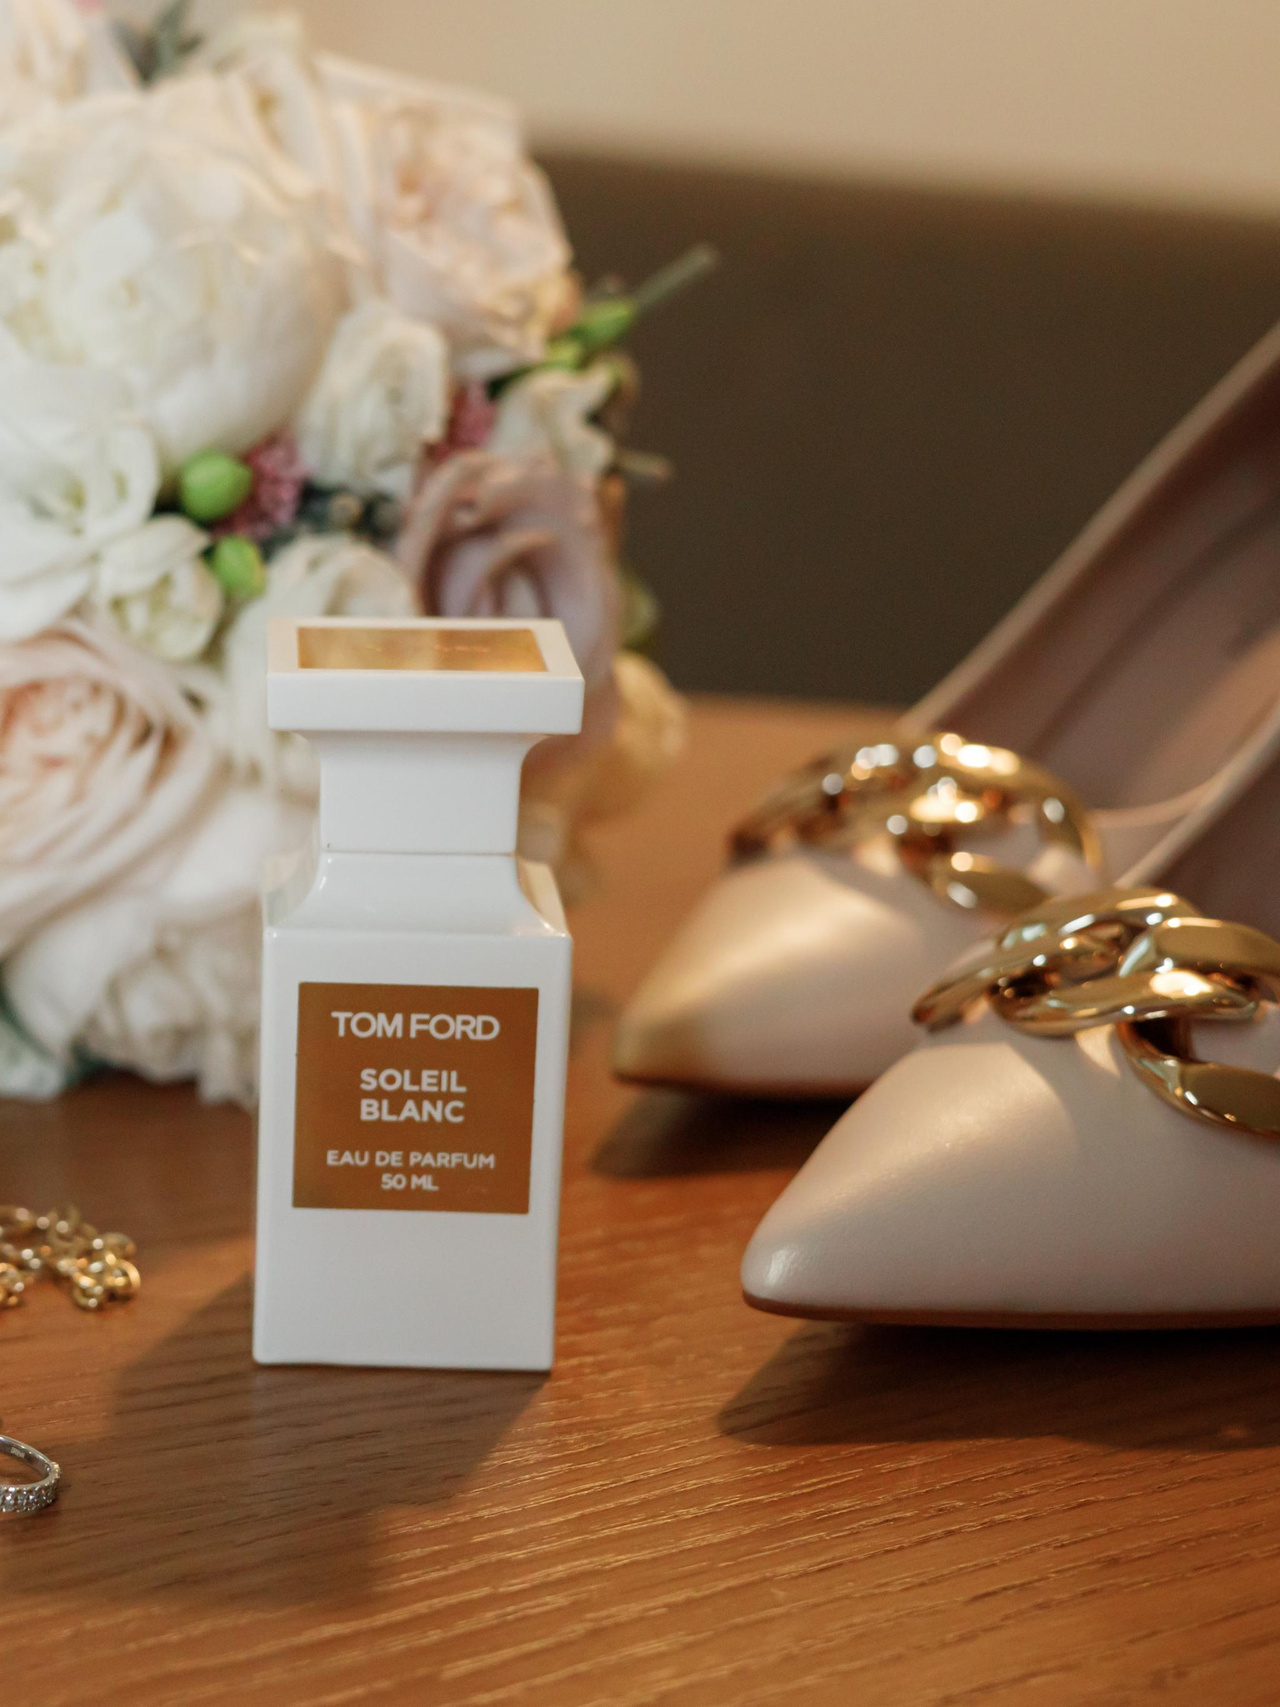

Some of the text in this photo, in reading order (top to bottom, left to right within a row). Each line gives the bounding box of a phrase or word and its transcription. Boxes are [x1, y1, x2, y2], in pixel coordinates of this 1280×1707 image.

[331, 1011, 501, 1041] TOM FORD
[360, 1068, 467, 1093] SOLEIL
[360, 1098, 465, 1123] BLANC
[326, 1149, 496, 1169] EAU DE PARFUM
[380, 1173, 439, 1192] 50 ML
